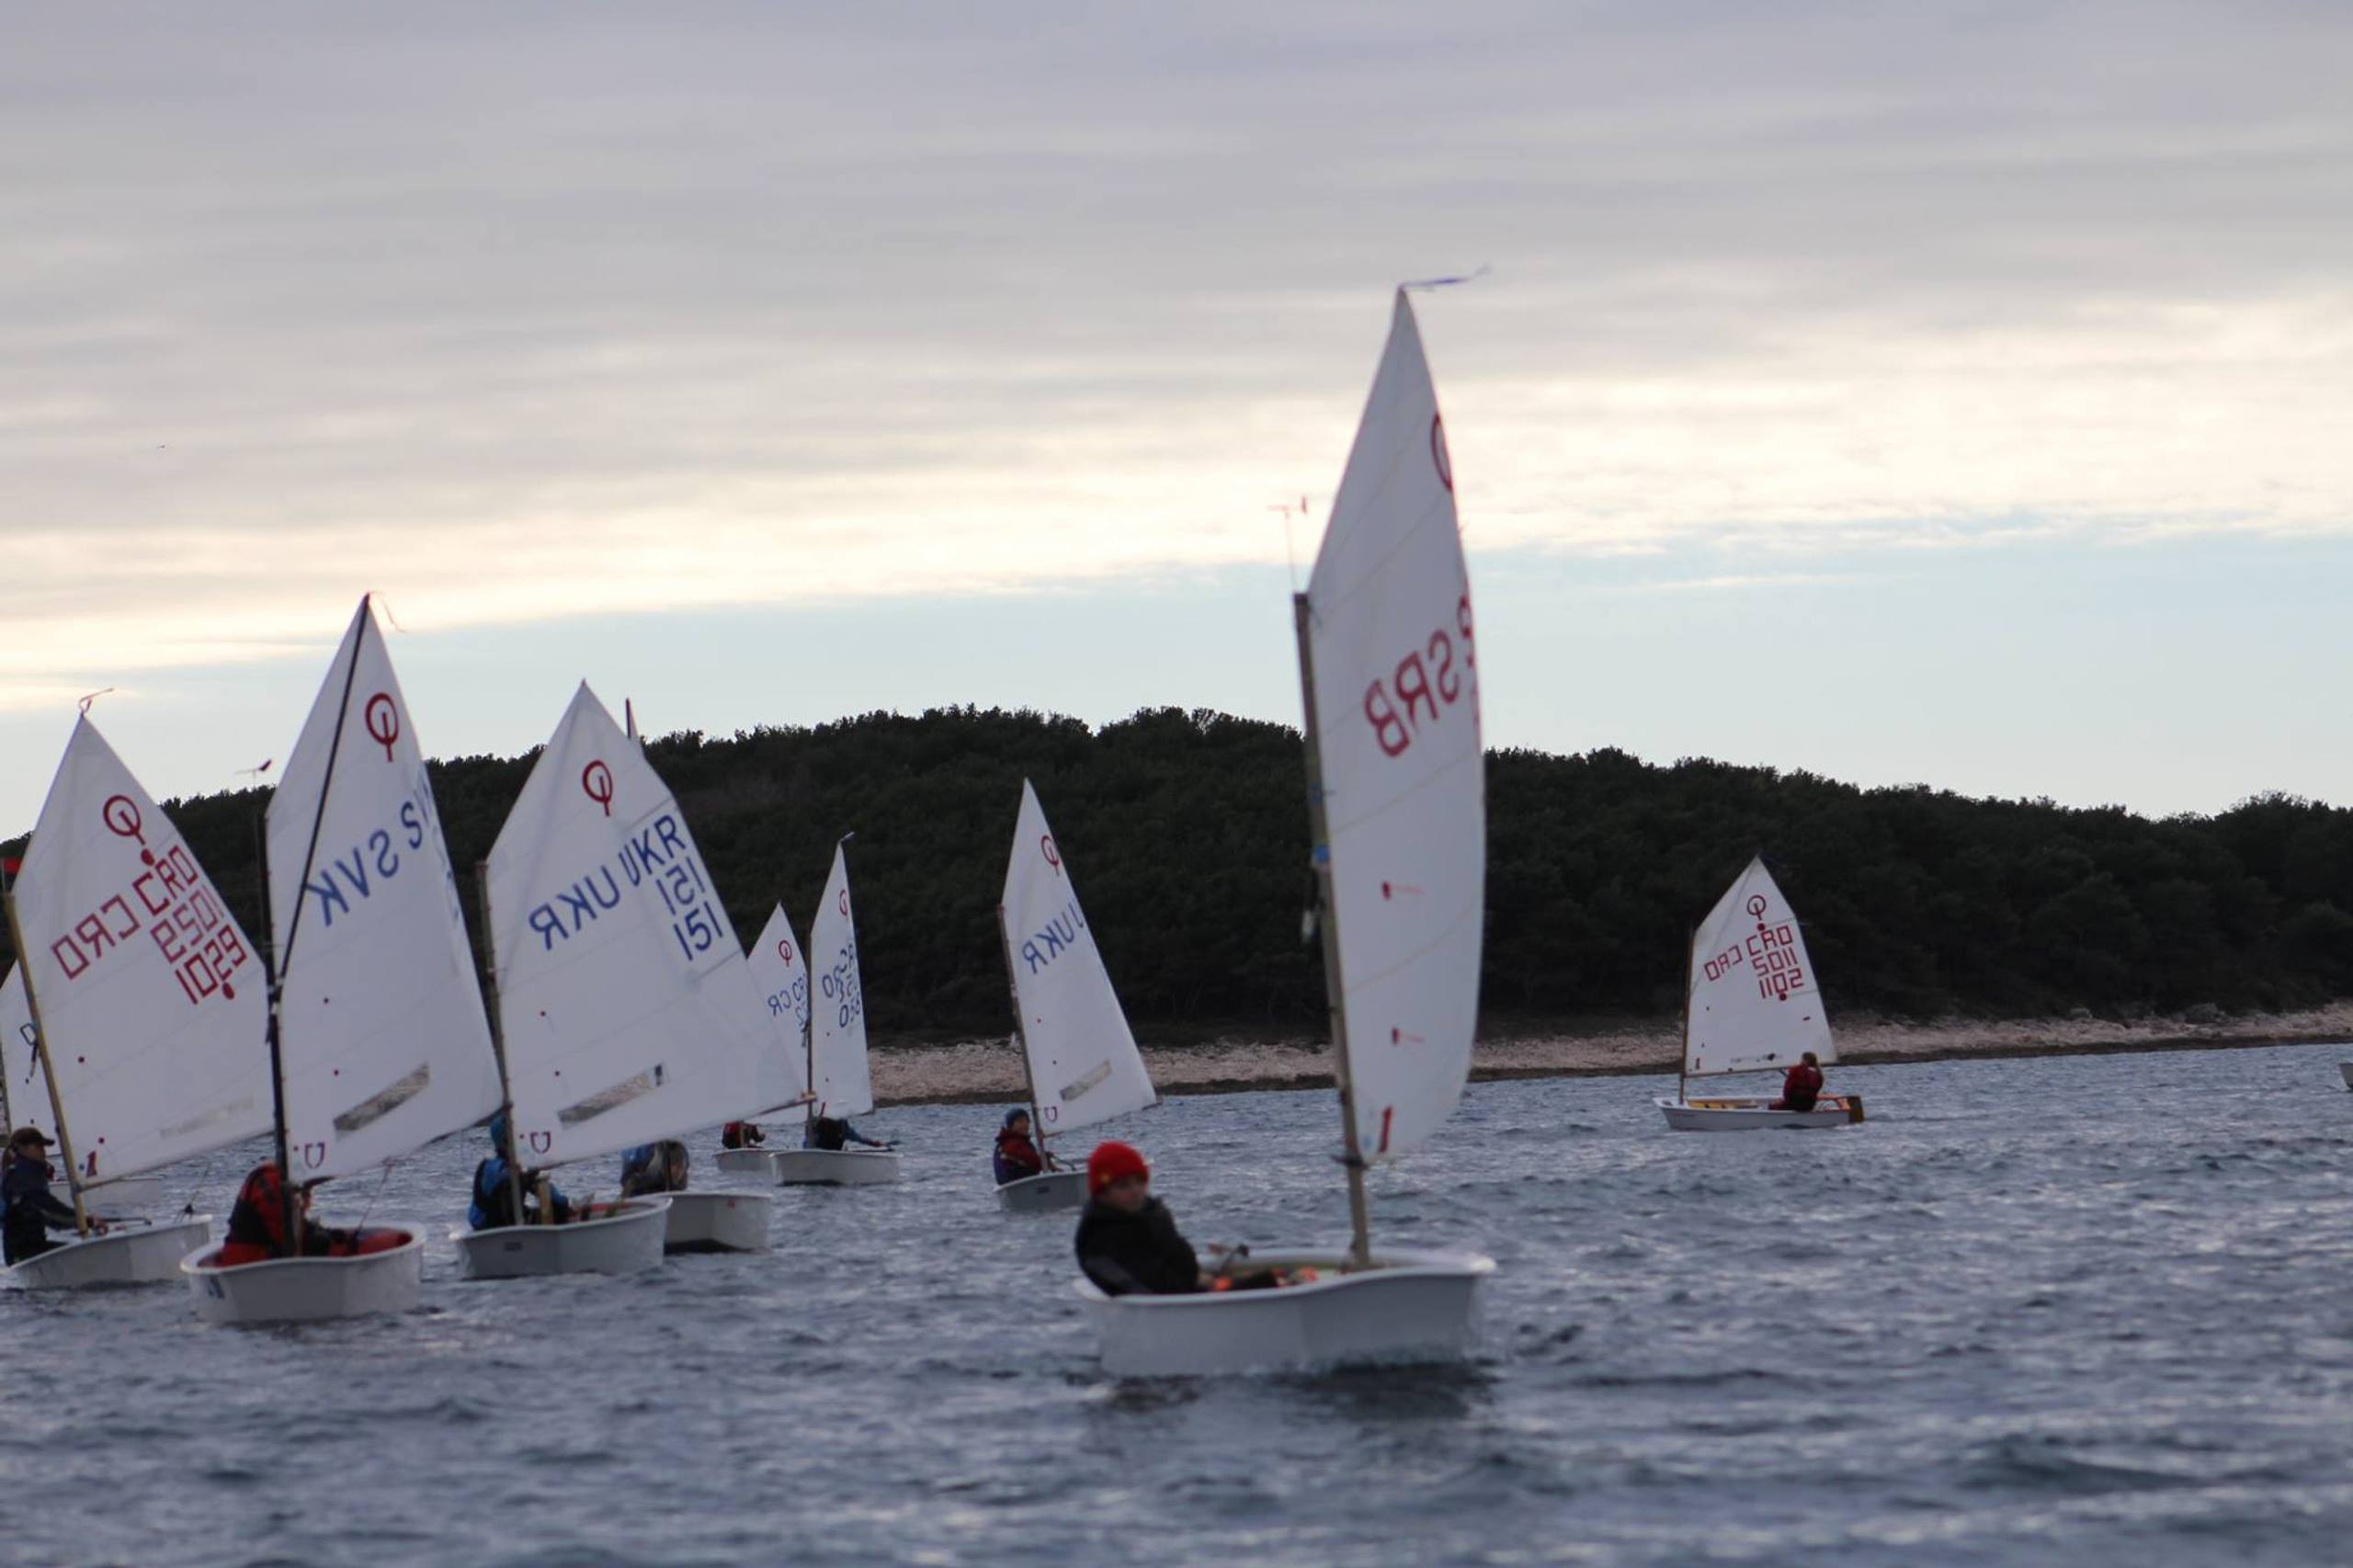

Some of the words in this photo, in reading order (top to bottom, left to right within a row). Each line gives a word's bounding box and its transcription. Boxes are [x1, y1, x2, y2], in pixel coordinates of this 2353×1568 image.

[132, 845, 199, 916] CRO
[619, 814, 687, 887] UKR
[175, 924, 248, 1005] 1029
[673, 901, 724, 961] 151
[1746, 926, 1793, 957] CRO
